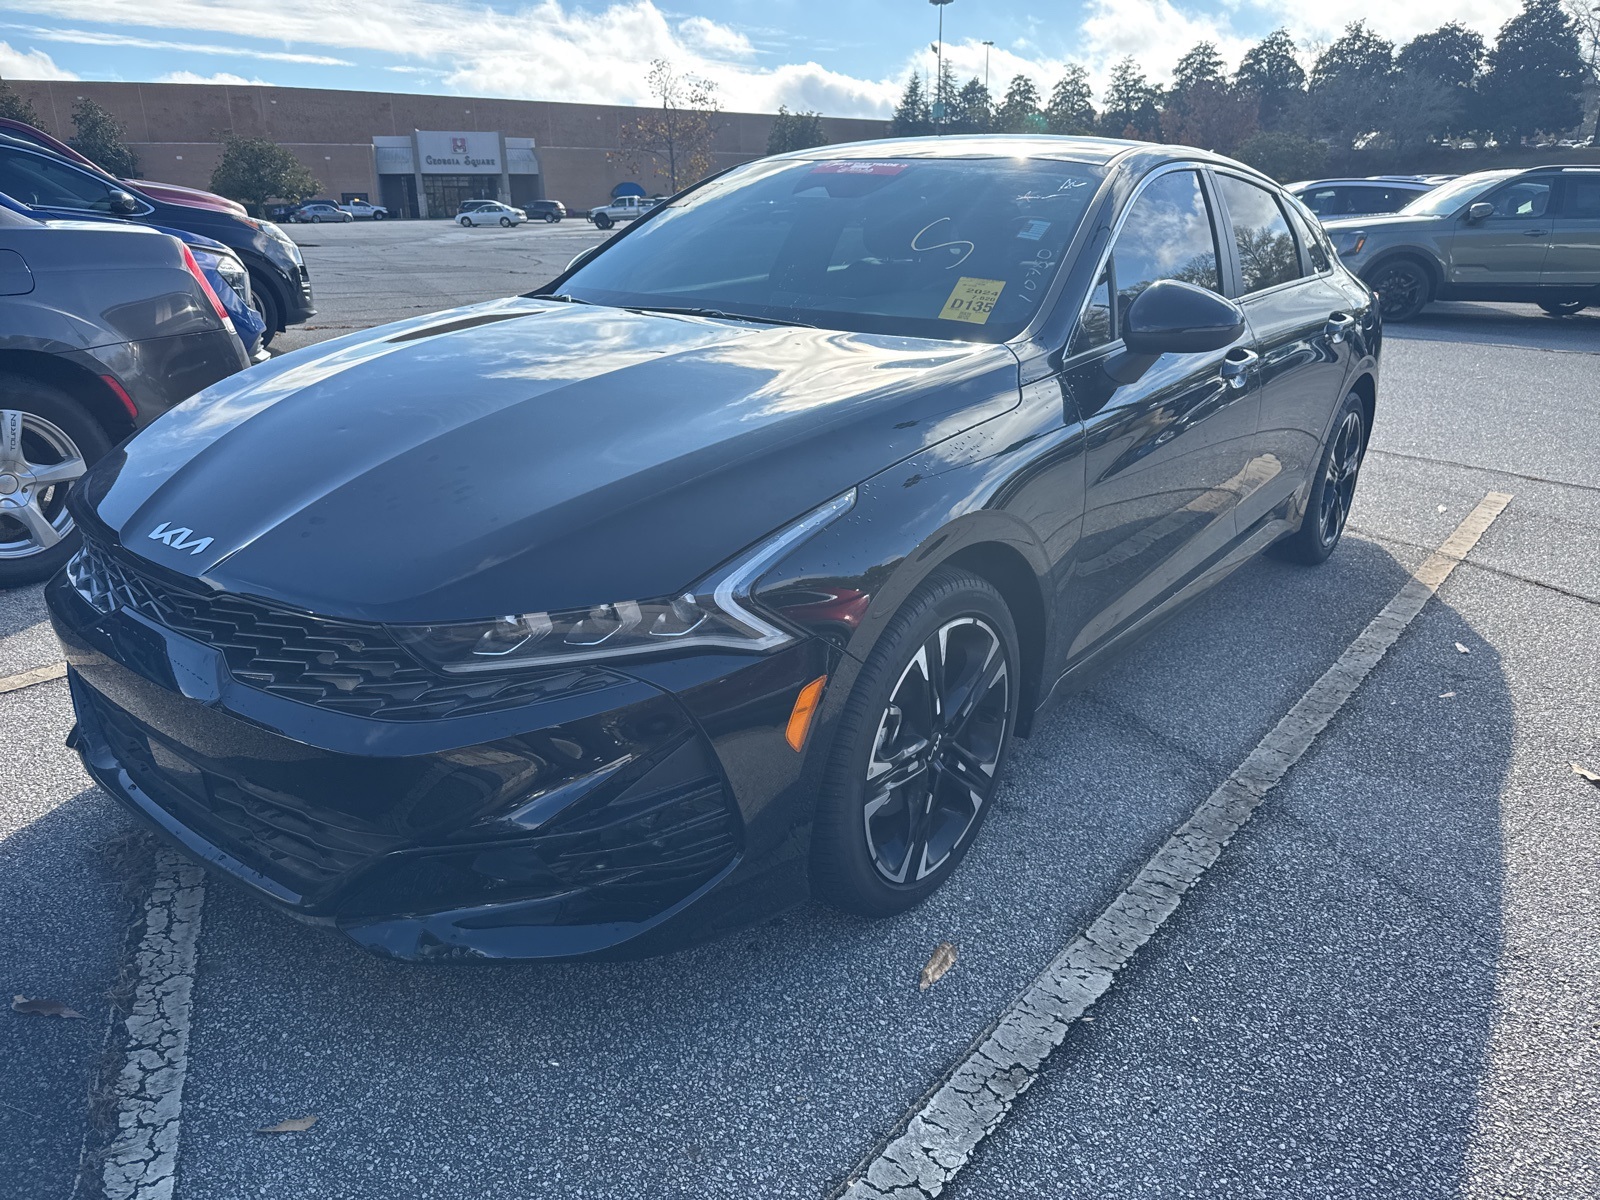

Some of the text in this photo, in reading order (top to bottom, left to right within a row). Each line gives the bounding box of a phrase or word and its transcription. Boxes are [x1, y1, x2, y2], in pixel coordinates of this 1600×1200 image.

[965, 287, 999, 297] 2024
[950, 298, 995, 313] D135
[9, 413, 17, 451] TOUREN
